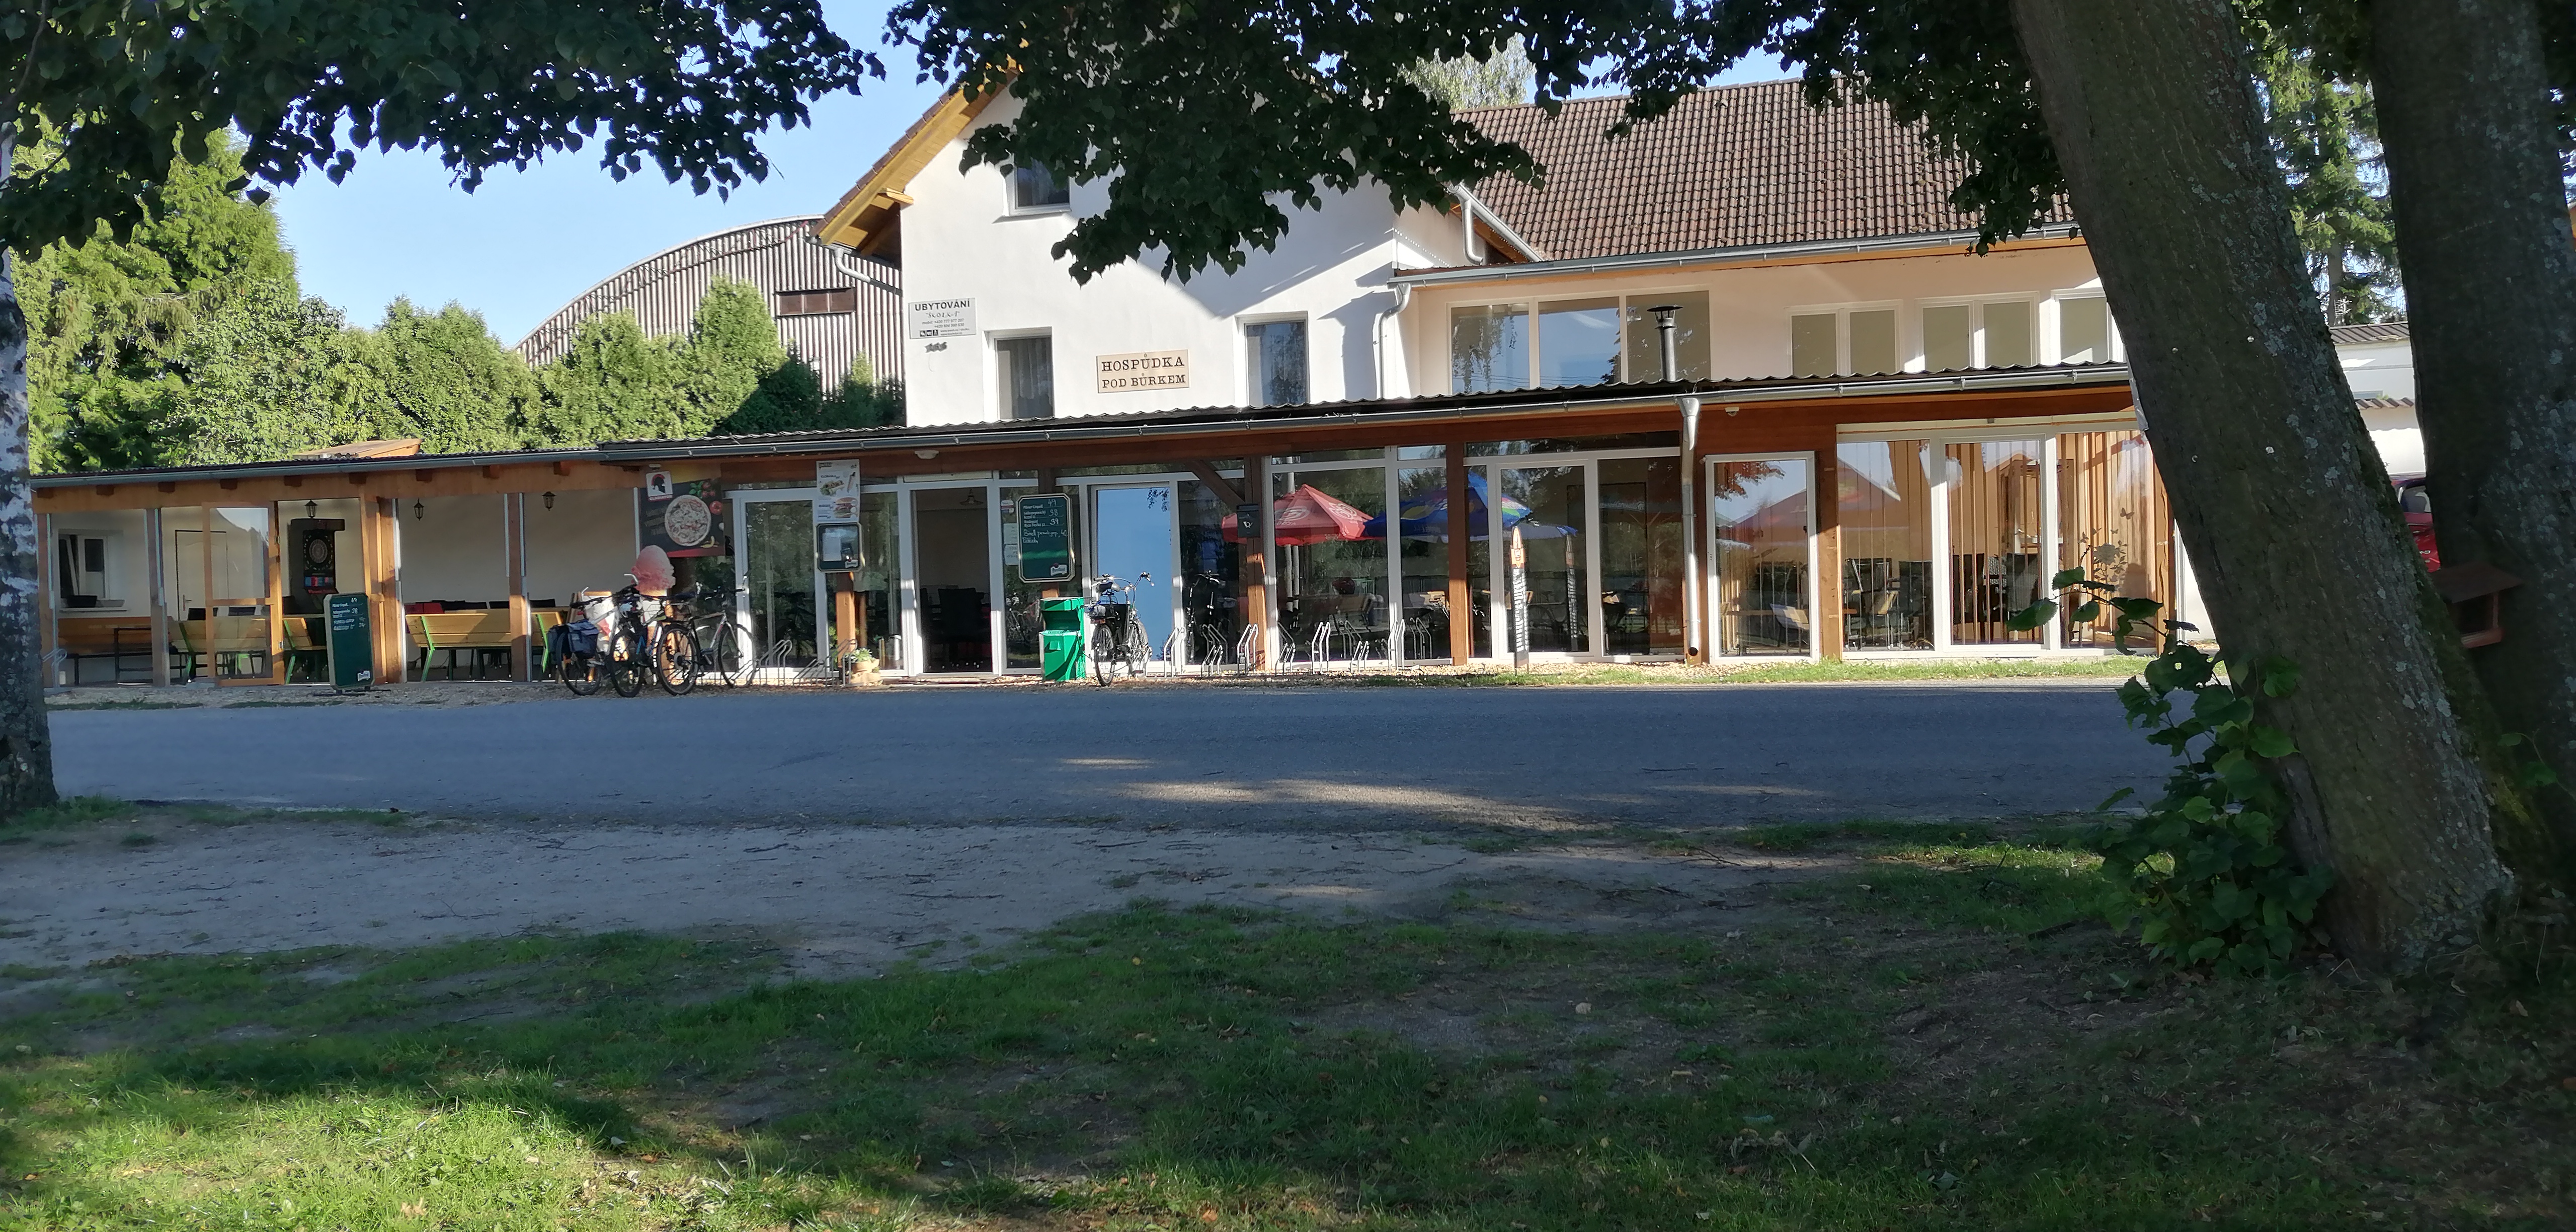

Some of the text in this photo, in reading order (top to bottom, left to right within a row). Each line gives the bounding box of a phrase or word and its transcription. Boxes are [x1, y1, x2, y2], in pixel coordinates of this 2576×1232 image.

[915, 298, 970, 311] UBYTOVÁNÍ
[1101, 353, 1184, 371] HOSPŮDKA
[1102, 373, 1185, 388] POD BŮRKEM
